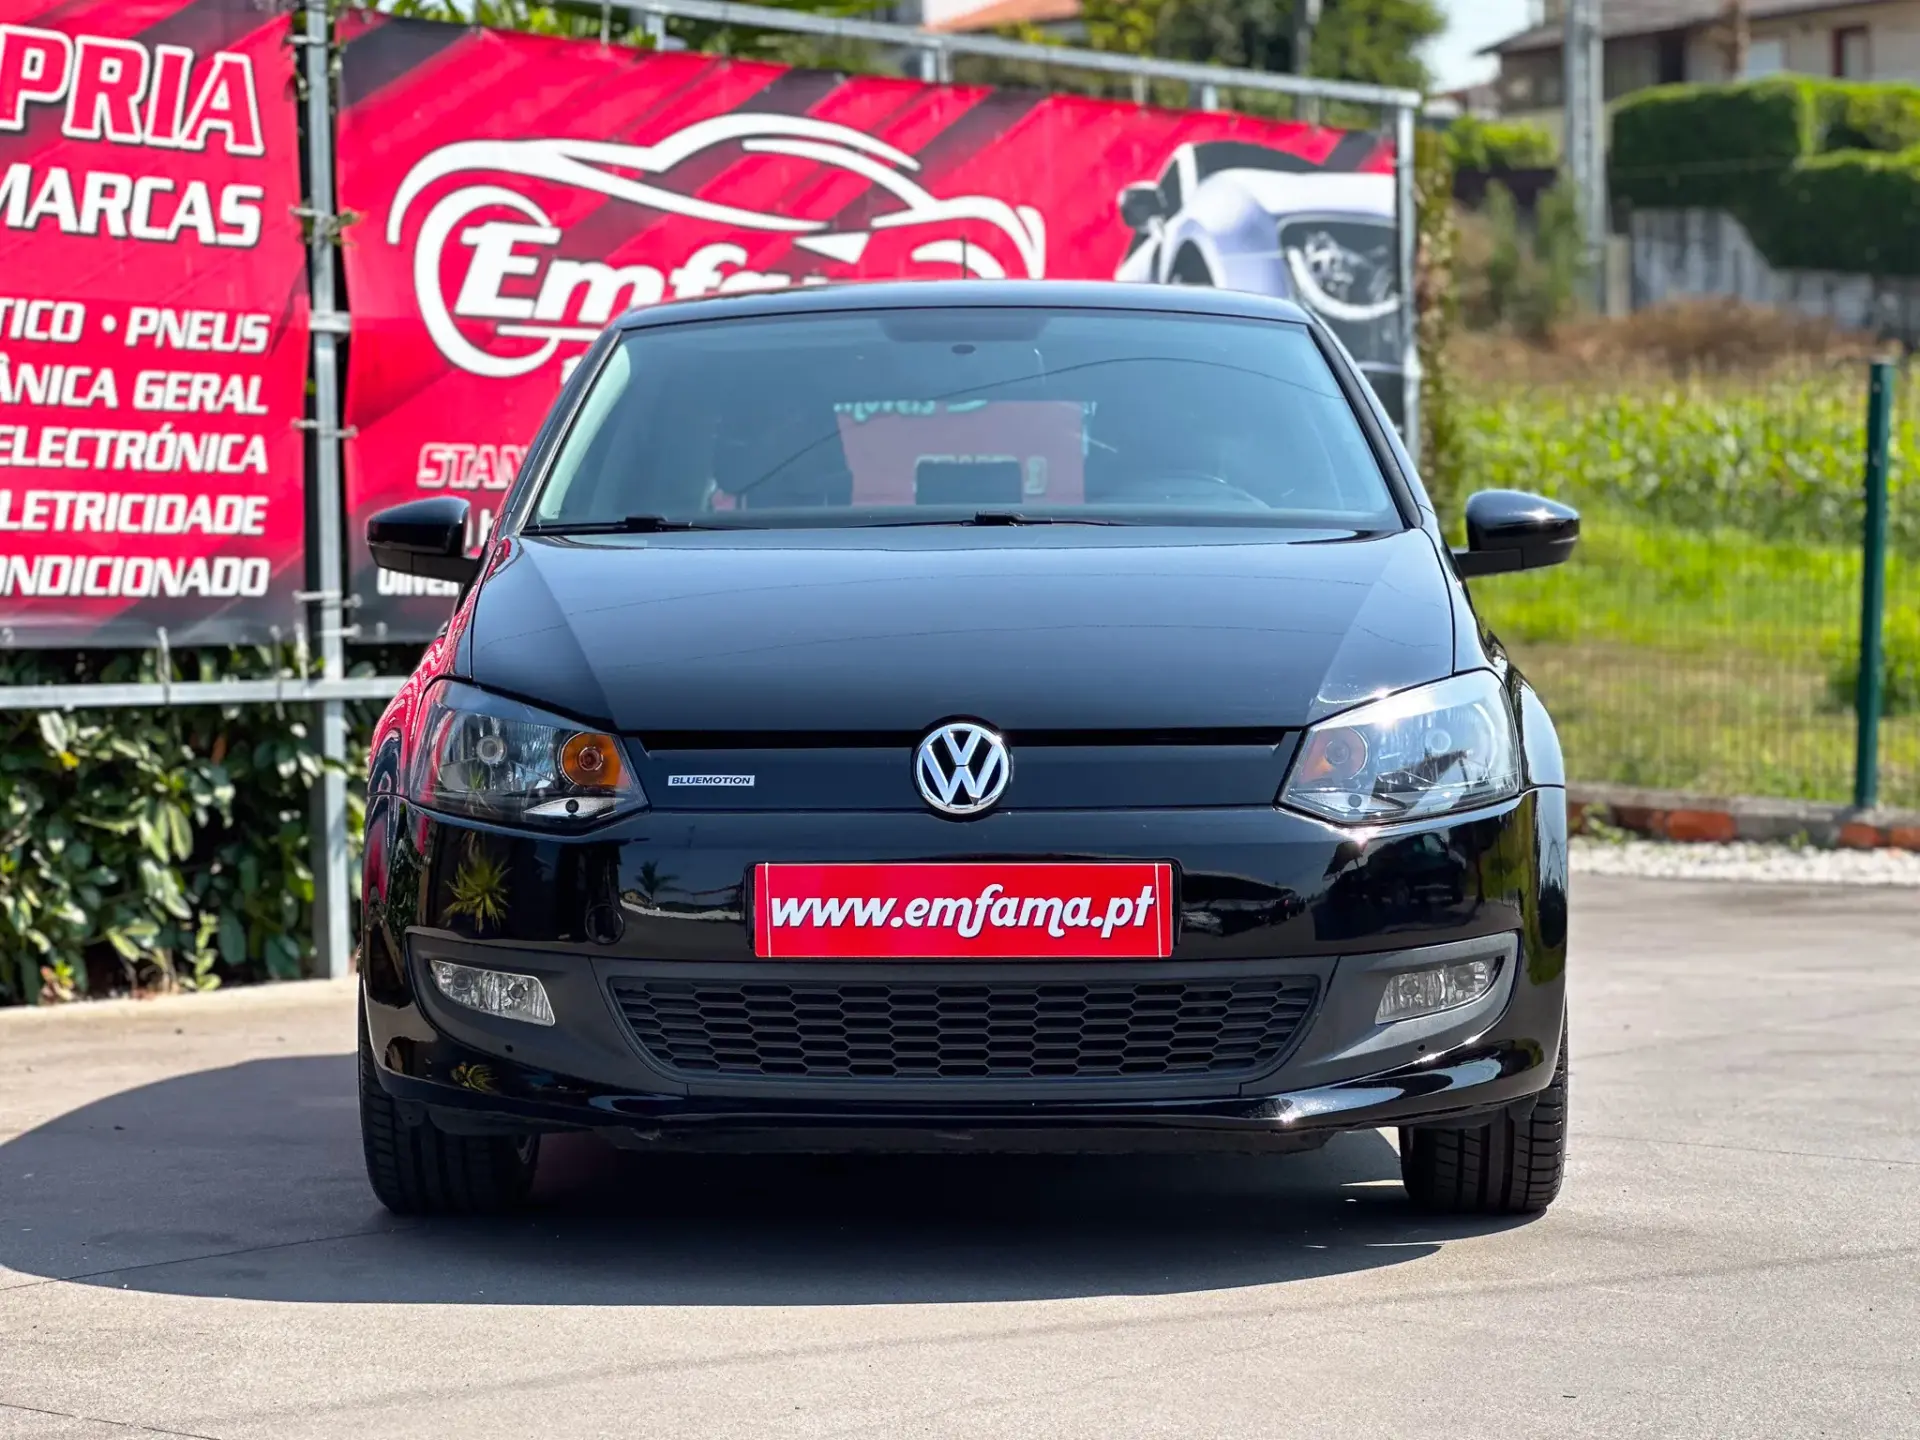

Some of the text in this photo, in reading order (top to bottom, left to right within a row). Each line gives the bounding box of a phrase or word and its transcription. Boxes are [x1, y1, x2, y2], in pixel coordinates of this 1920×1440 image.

[0, 24, 264, 156] PRIA
[124, 306, 271, 353] PNEUS
[132, 370, 269, 415] GERAL
[0, 489, 269, 535] LETRICIDADE
[0, 555, 271, 597] NDICIONADO
[670, 775, 752, 786] BLUEMOTION
[771, 883, 1155, 938] www.emfama.pt
